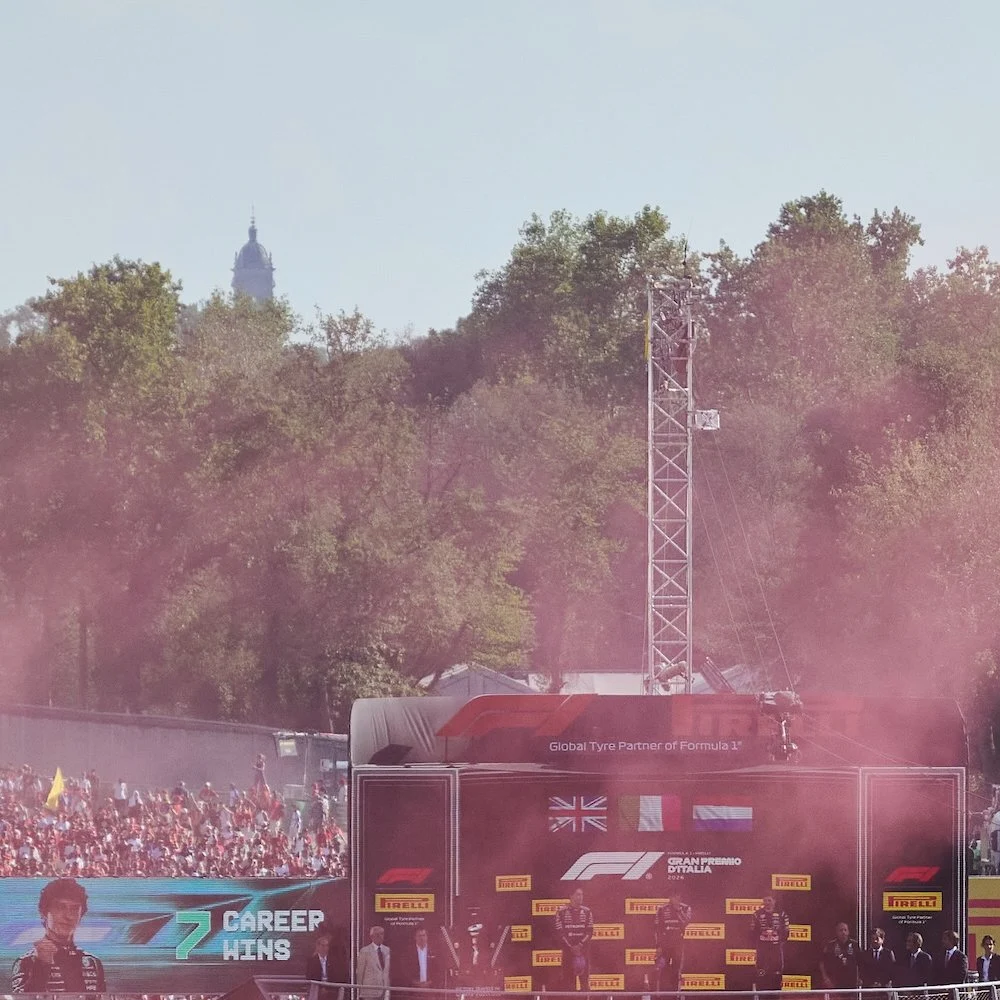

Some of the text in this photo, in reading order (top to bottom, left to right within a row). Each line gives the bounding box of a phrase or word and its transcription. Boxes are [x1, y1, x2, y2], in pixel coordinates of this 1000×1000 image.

[549, 741, 587, 751] Global
[589, 741, 616, 752] Tyre
[618, 741, 661, 751] Partner
[664, 740, 678, 751] of
[680, 740, 729, 751] Formula
[667, 857, 742, 866] GRAN PREMIO
[667, 866, 712, 874] D'ITALIA
[498, 877, 528, 888] PIRELLI
[775, 877, 808, 888] PIRELLI
[380, 897, 430, 909] PIRELLI
[887, 895, 937, 907] PIRELLI
[223, 910, 325, 932] CAREER
[176, 911, 212, 960] 7
[223, 939, 291, 960] WINS
